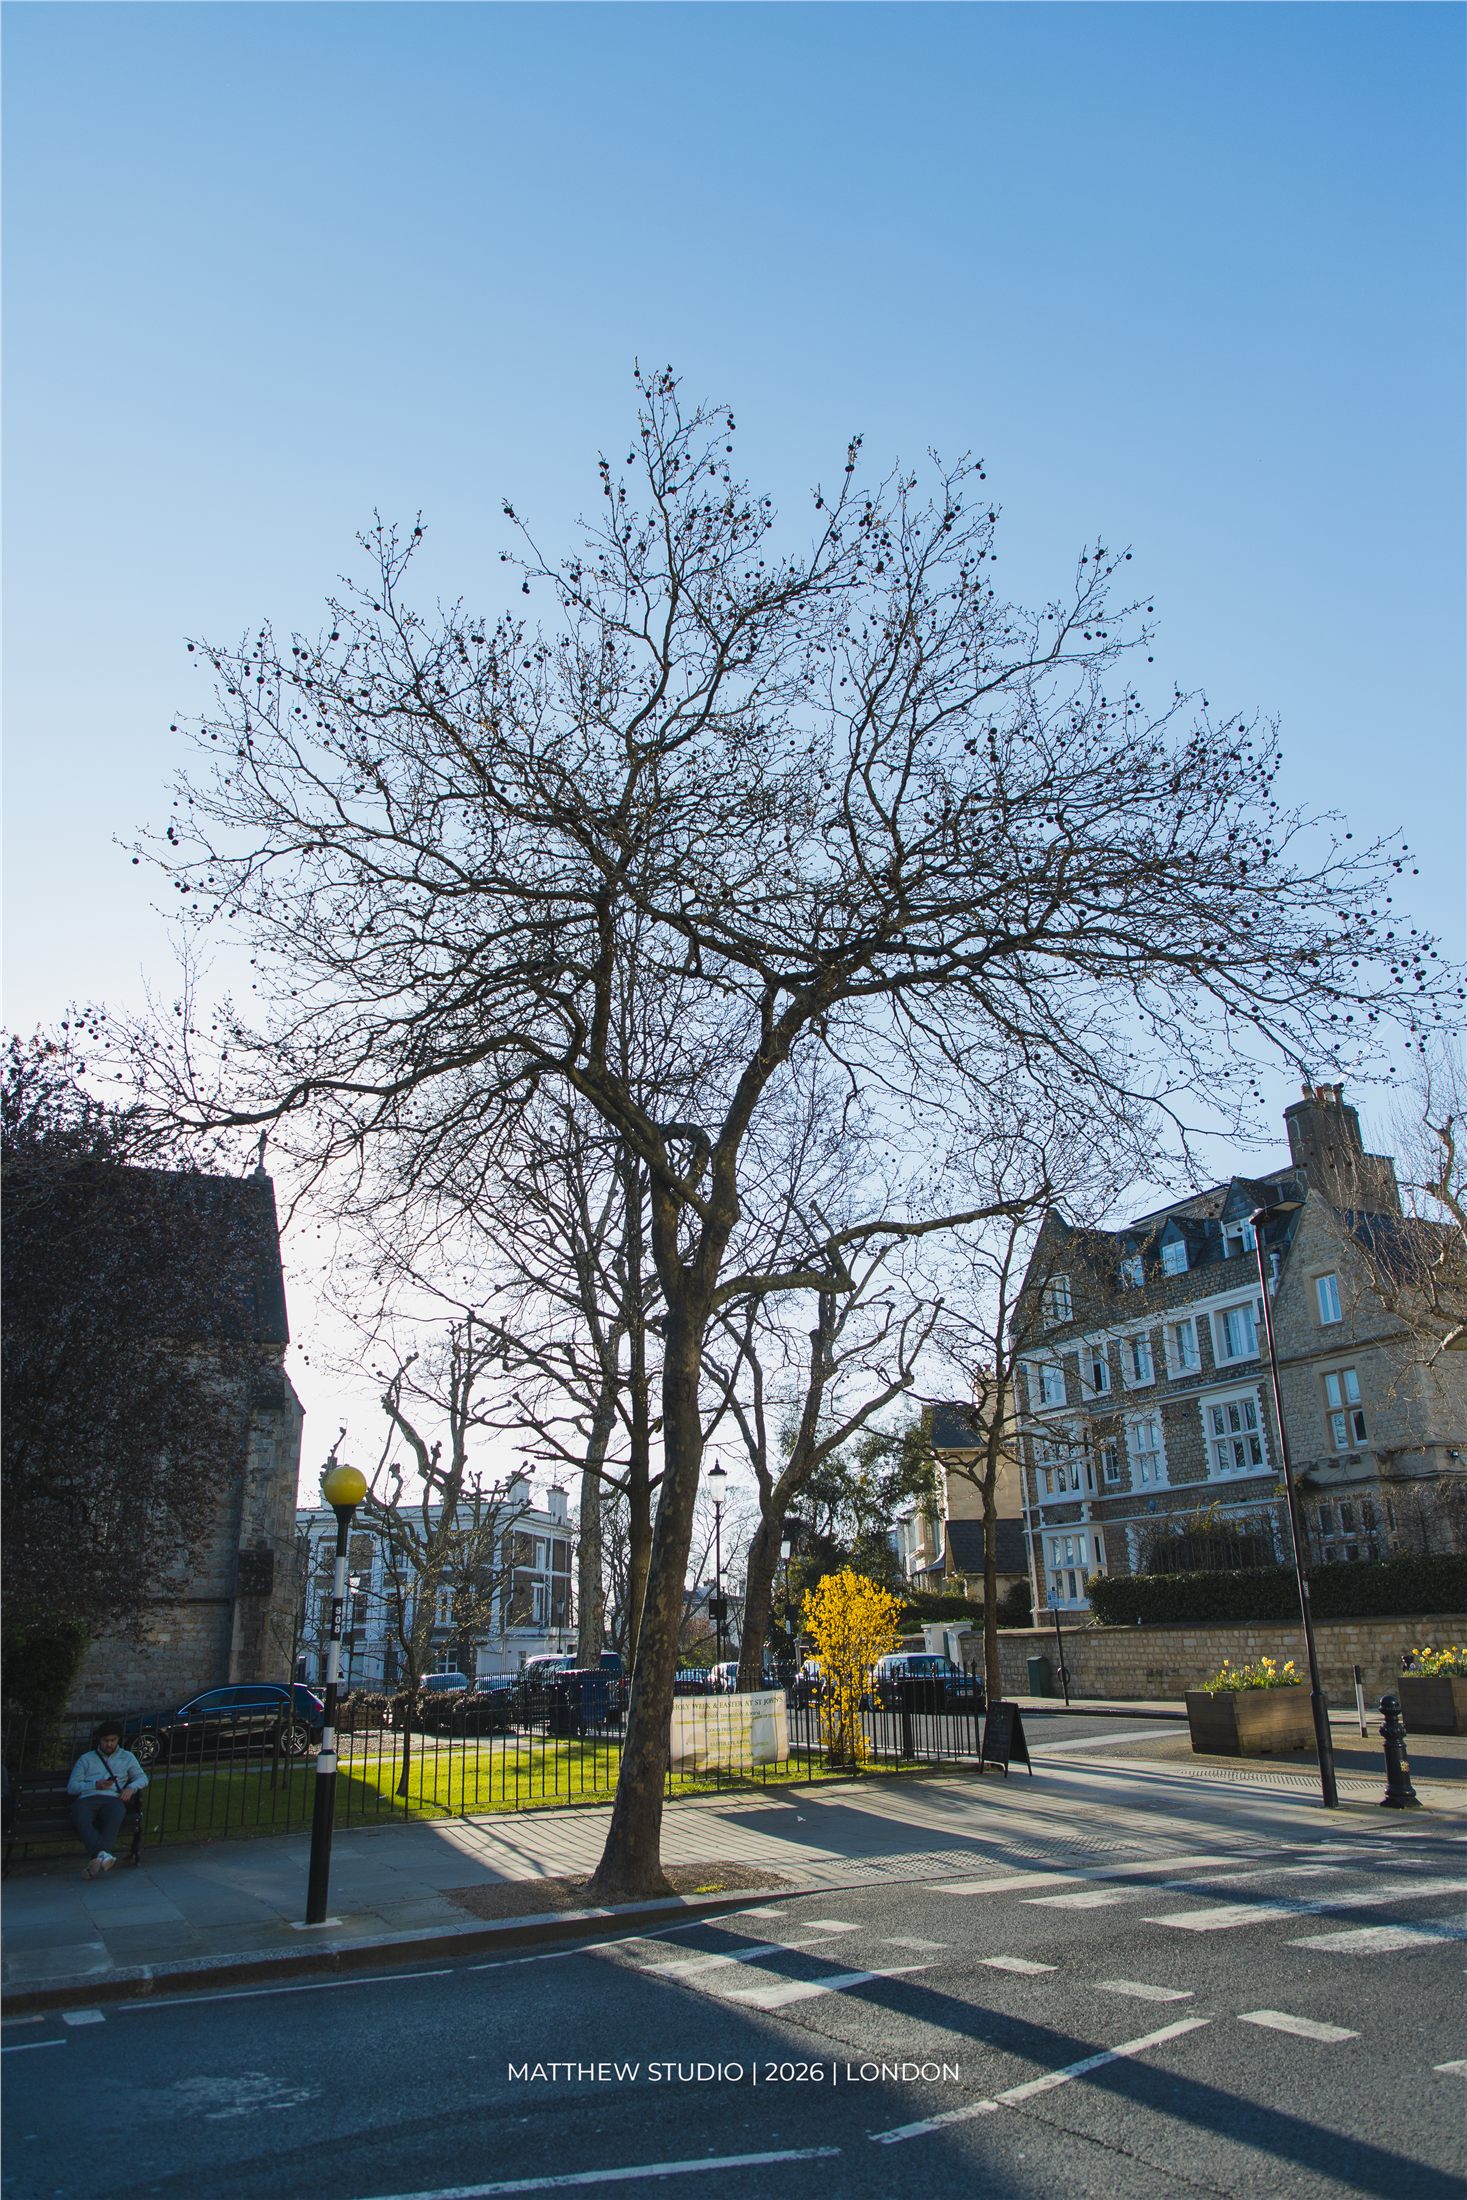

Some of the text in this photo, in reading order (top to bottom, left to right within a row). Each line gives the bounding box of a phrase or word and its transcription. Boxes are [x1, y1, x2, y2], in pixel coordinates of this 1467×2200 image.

[672, 1703, 690, 1711] HOLY
[692, 1702, 711, 1710] WEEK
[754, 1698, 763, 1706] ST
